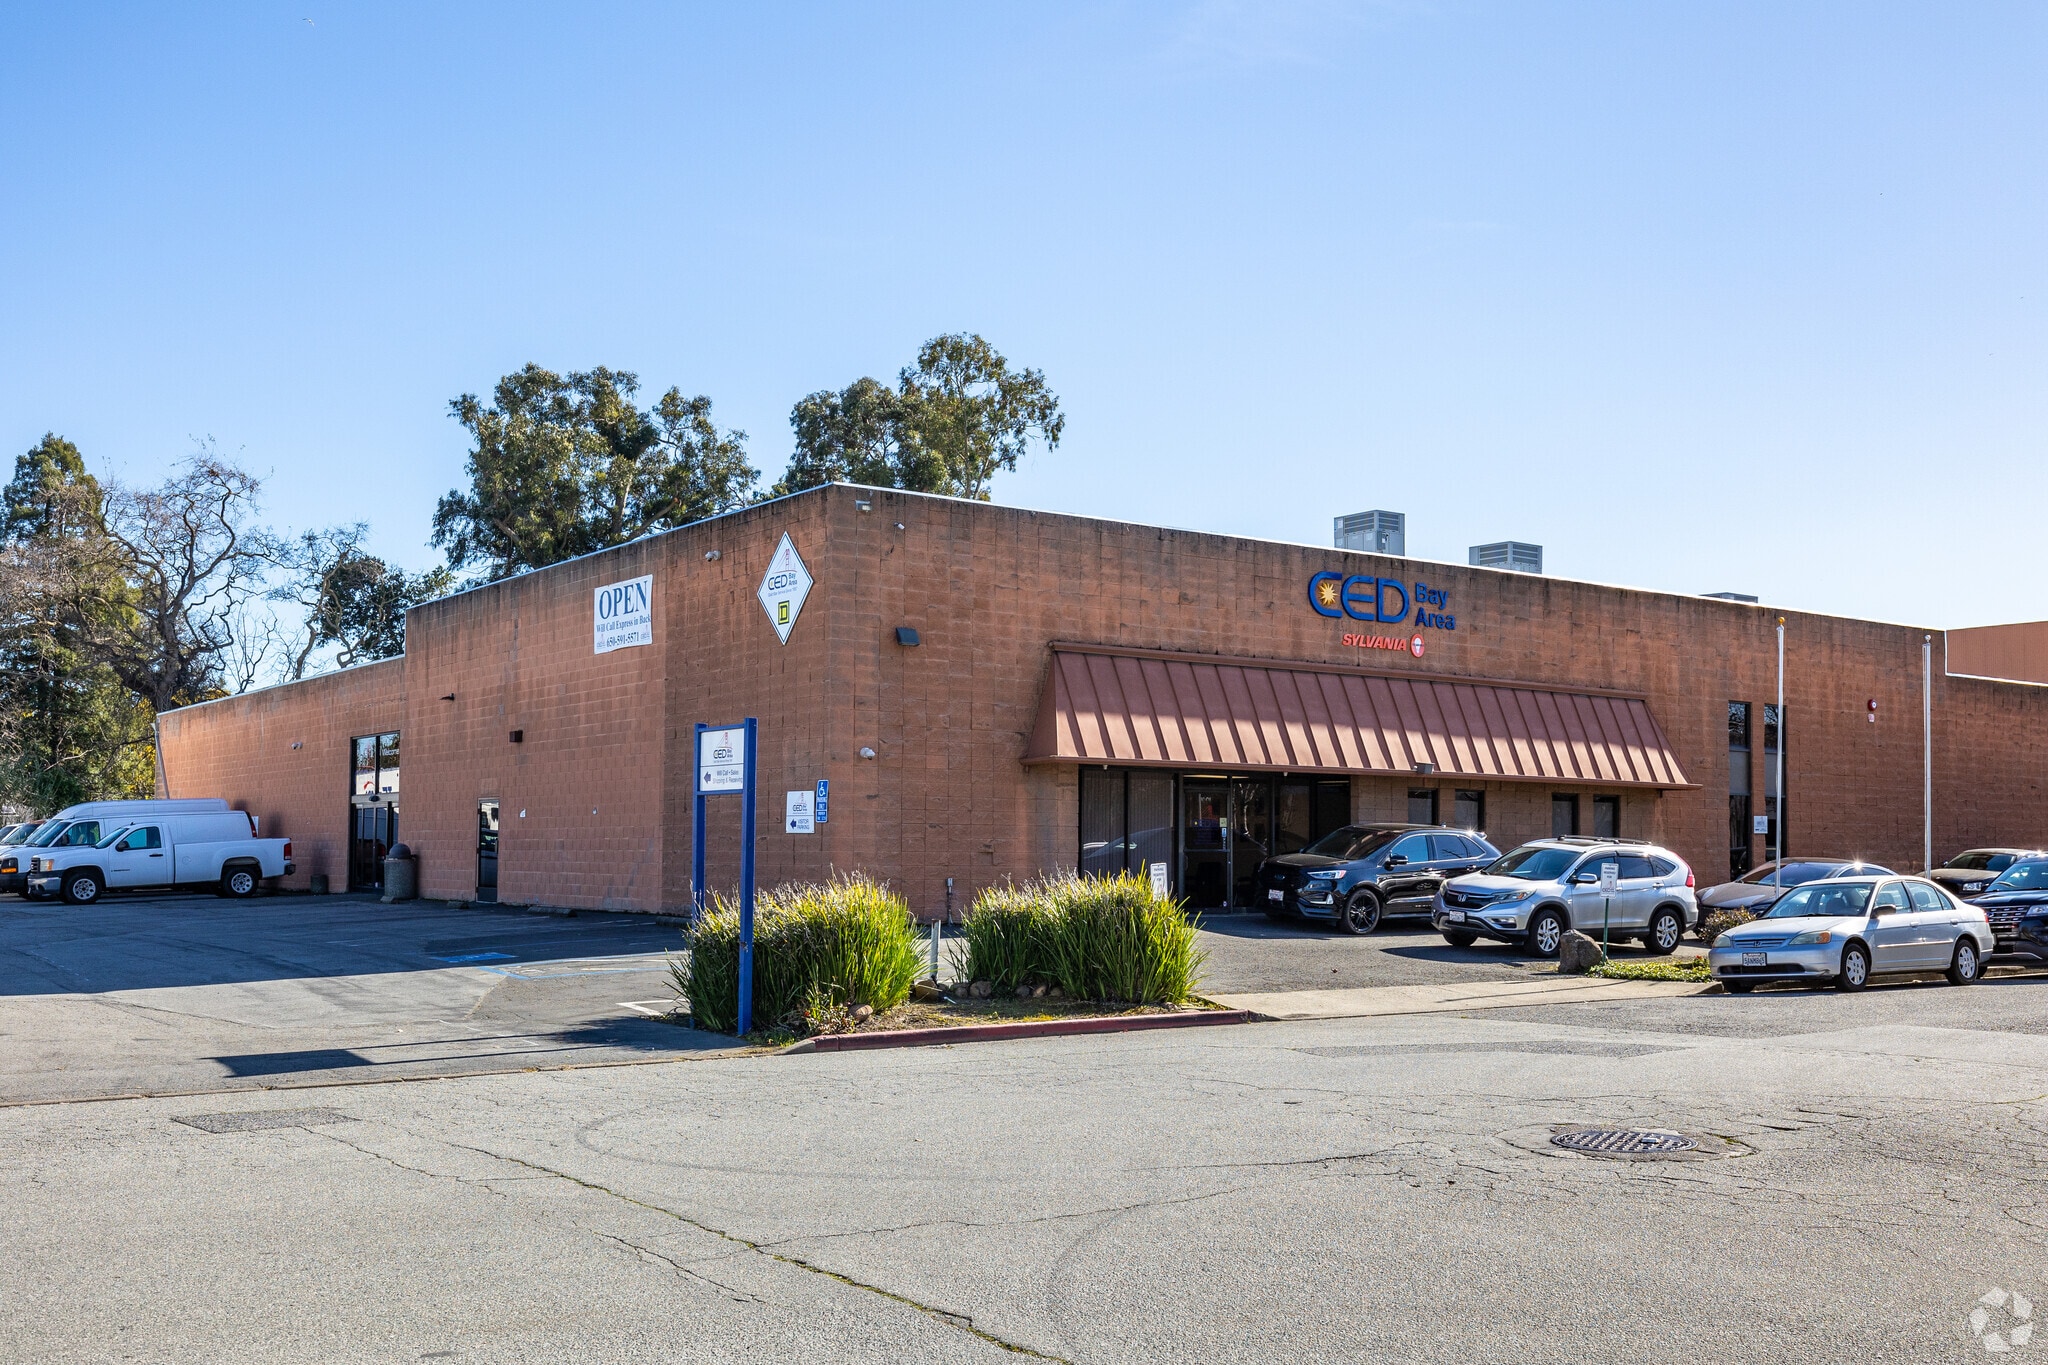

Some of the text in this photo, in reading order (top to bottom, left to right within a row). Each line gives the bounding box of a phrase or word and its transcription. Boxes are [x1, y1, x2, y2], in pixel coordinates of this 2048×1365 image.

[768, 574, 788, 590] CED
[599, 581, 647, 619] OPEN
[1308, 571, 1410, 623] CED
[1415, 583, 1449, 610] Bay
[596, 614, 651, 632] Will Call Express in Back
[1415, 607, 1455, 630] Area
[607, 632, 639, 647] 650-591-5571
[1342, 633, 1407, 651] SYLVANIA
[713, 749, 726, 759] CED
